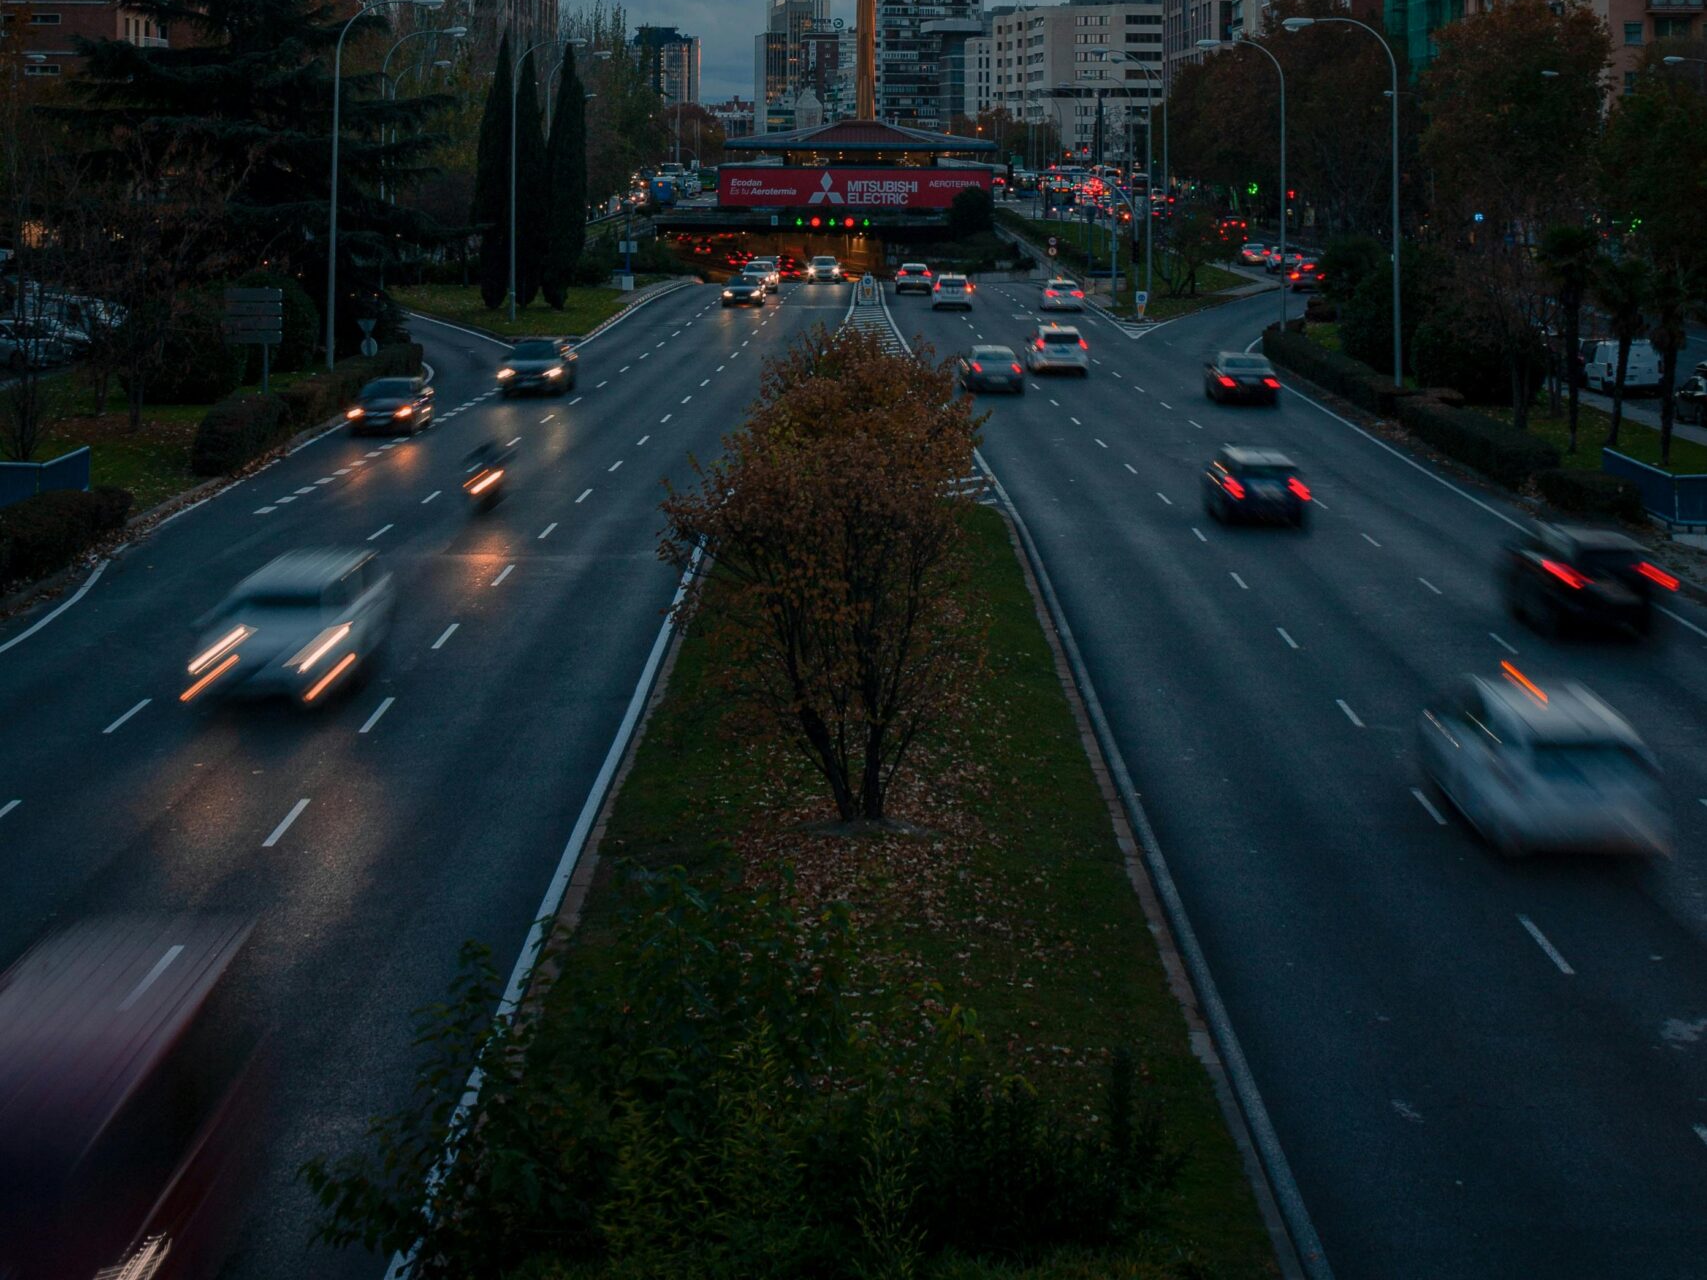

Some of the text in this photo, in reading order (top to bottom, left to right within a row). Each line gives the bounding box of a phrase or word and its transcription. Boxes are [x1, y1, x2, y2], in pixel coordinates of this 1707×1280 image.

[730, 178, 762, 187] Ecodan
[847, 180, 918, 193] MITSUBISHI
[929, 180, 981, 188] AEROTERMIA
[729, 187, 740, 195] Es
[741, 187, 750, 195] tu
[847, 192, 909, 205] ELECTRIC
